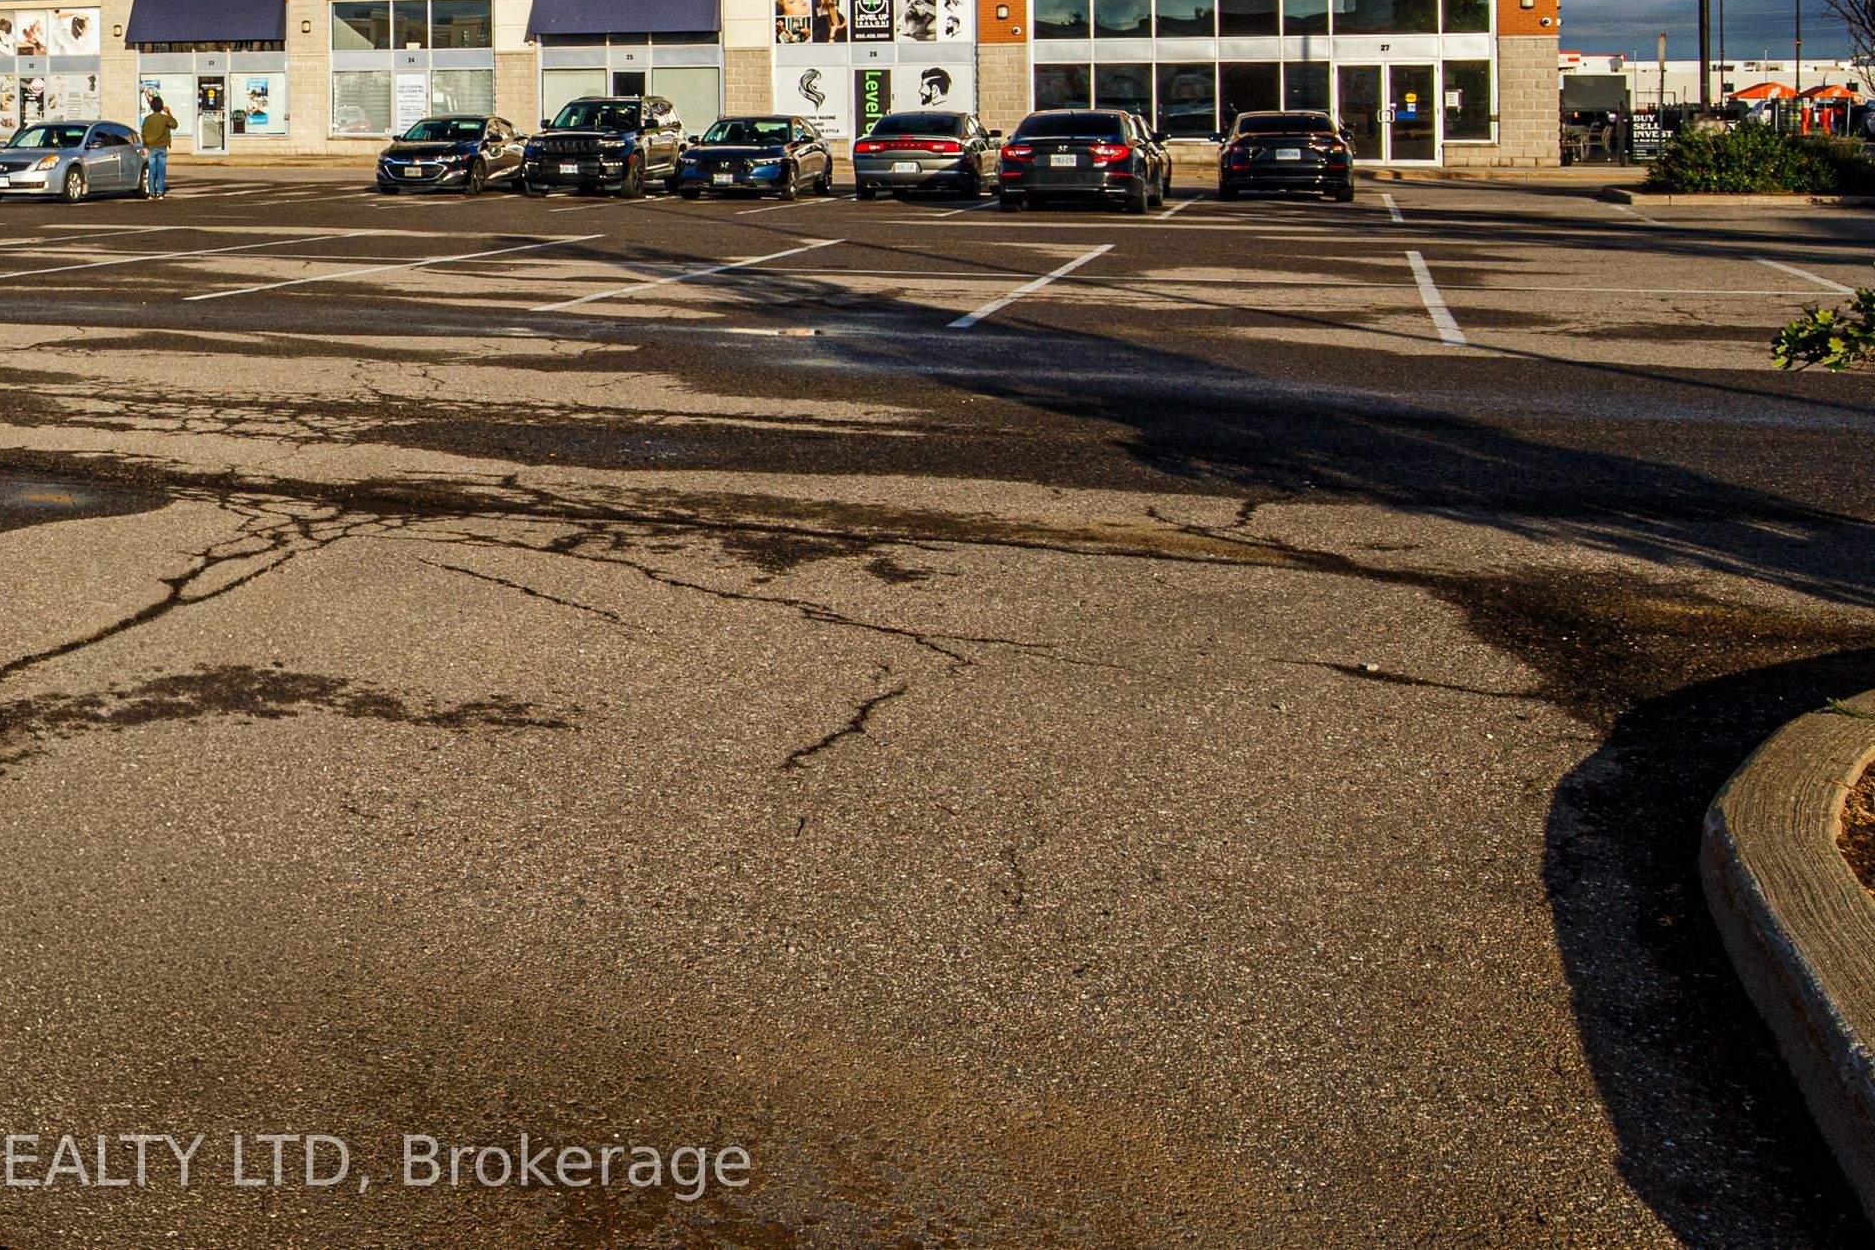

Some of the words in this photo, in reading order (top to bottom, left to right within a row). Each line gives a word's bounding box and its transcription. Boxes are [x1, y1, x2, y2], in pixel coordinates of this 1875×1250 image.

[865, 71, 883, 117] Level
[1633, 114, 1655, 122] BUY
[1633, 130, 1673, 138] INVEST
